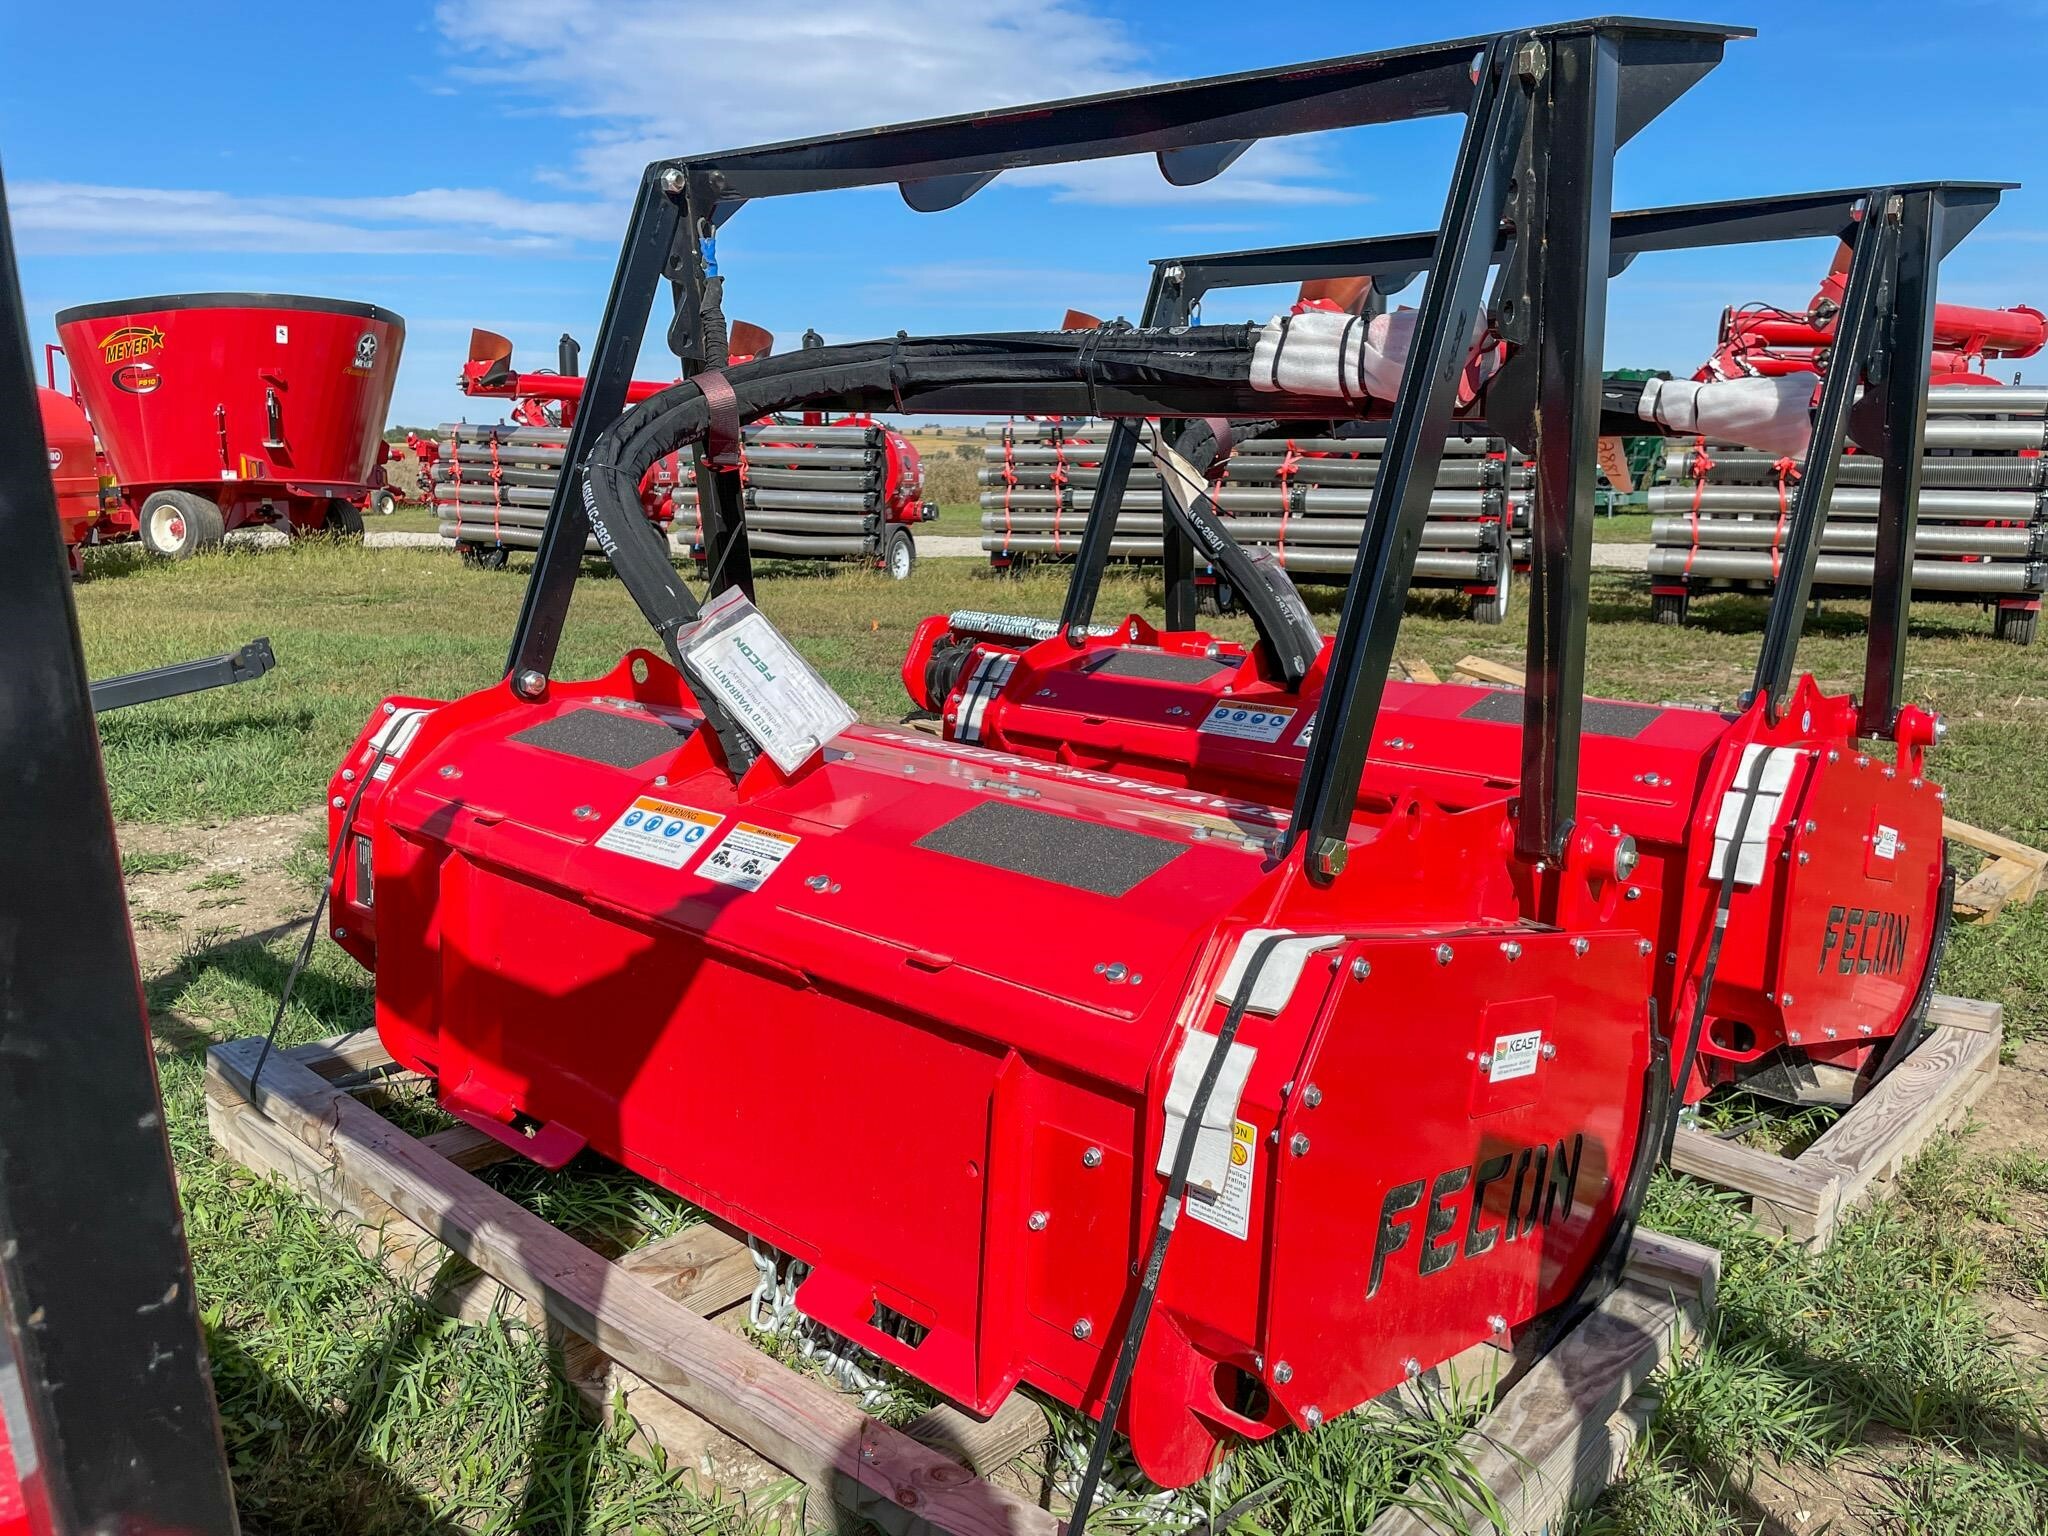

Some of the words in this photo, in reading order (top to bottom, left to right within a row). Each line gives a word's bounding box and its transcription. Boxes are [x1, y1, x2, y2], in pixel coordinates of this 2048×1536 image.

[106, 338, 149, 364] MEYER
[733, 636, 776, 682] FECON
[1069, 770, 1176, 795] BACK
[660, 805, 699, 820] WARNING
[1173, 795, 1293, 820] STAY
[1817, 905, 1909, 975] FECON
[1509, 1036, 1539, 1052] KEAST
[1365, 1133, 1583, 1300] FECON
